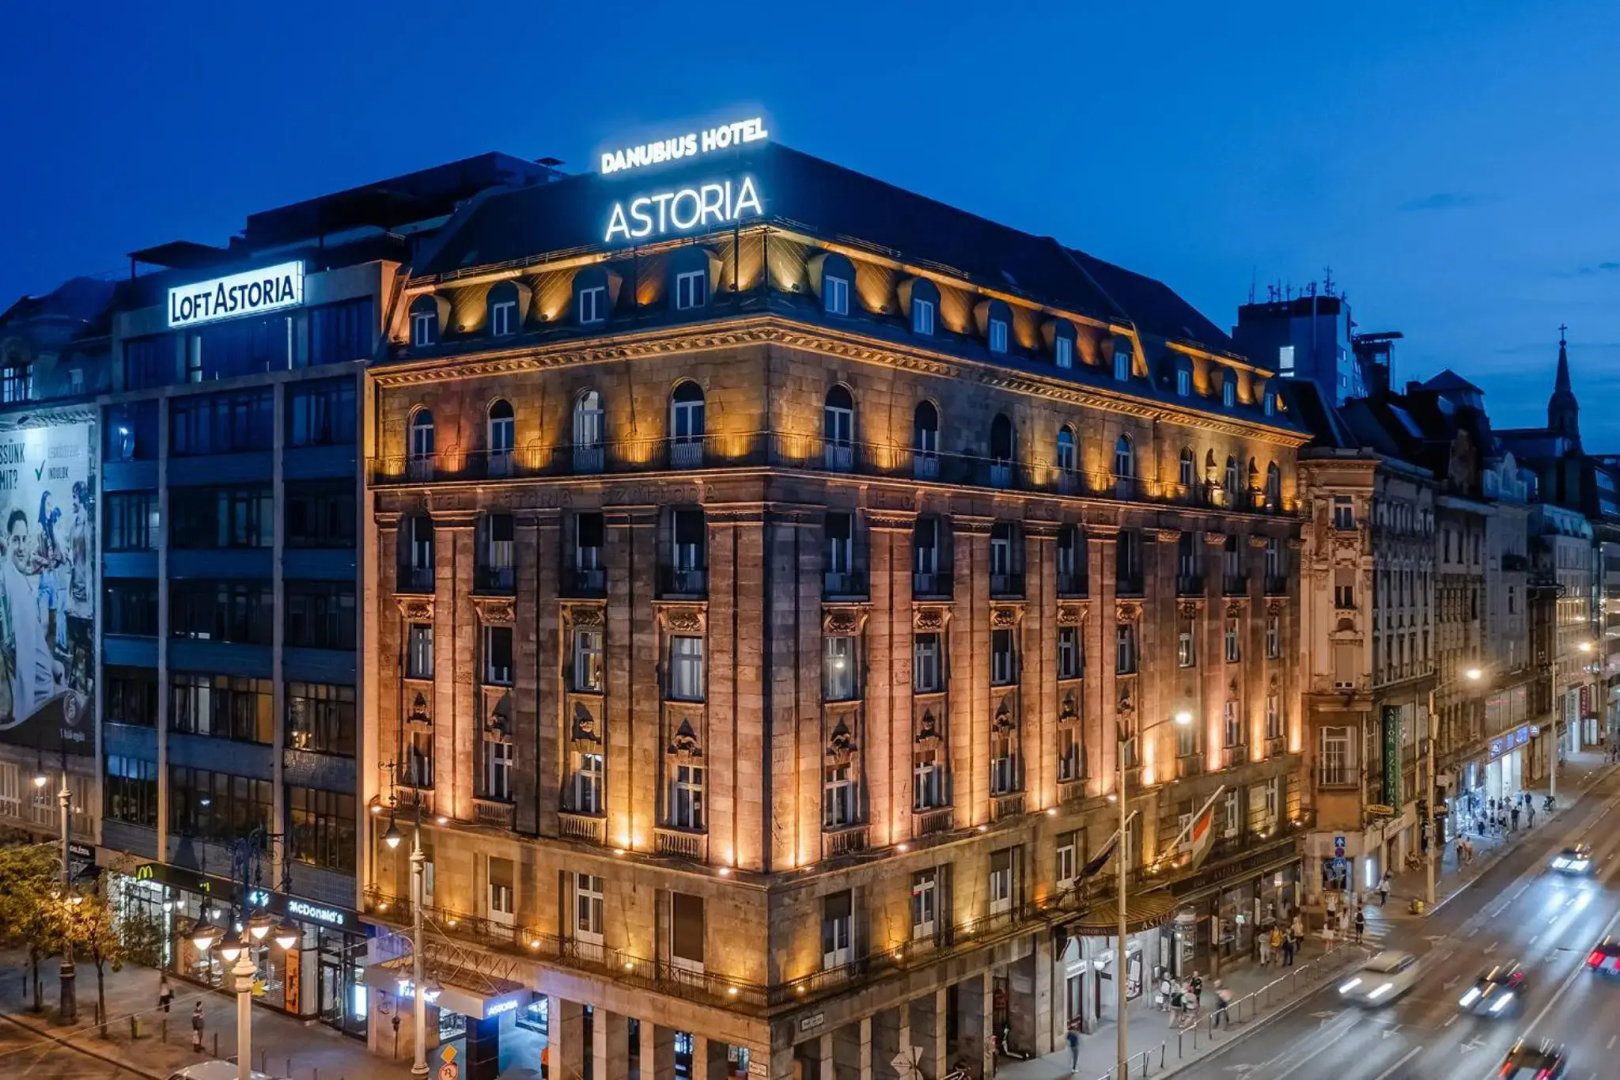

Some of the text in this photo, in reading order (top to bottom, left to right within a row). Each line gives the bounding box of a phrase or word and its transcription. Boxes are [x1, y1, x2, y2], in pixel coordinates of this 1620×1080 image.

[602, 118, 768, 174] DANUBIUS HOTEL
[605, 176, 763, 242] ASTORIA
[171, 275, 295, 322] LOFT ASTORIA
[288, 900, 344, 925] McDonald's
